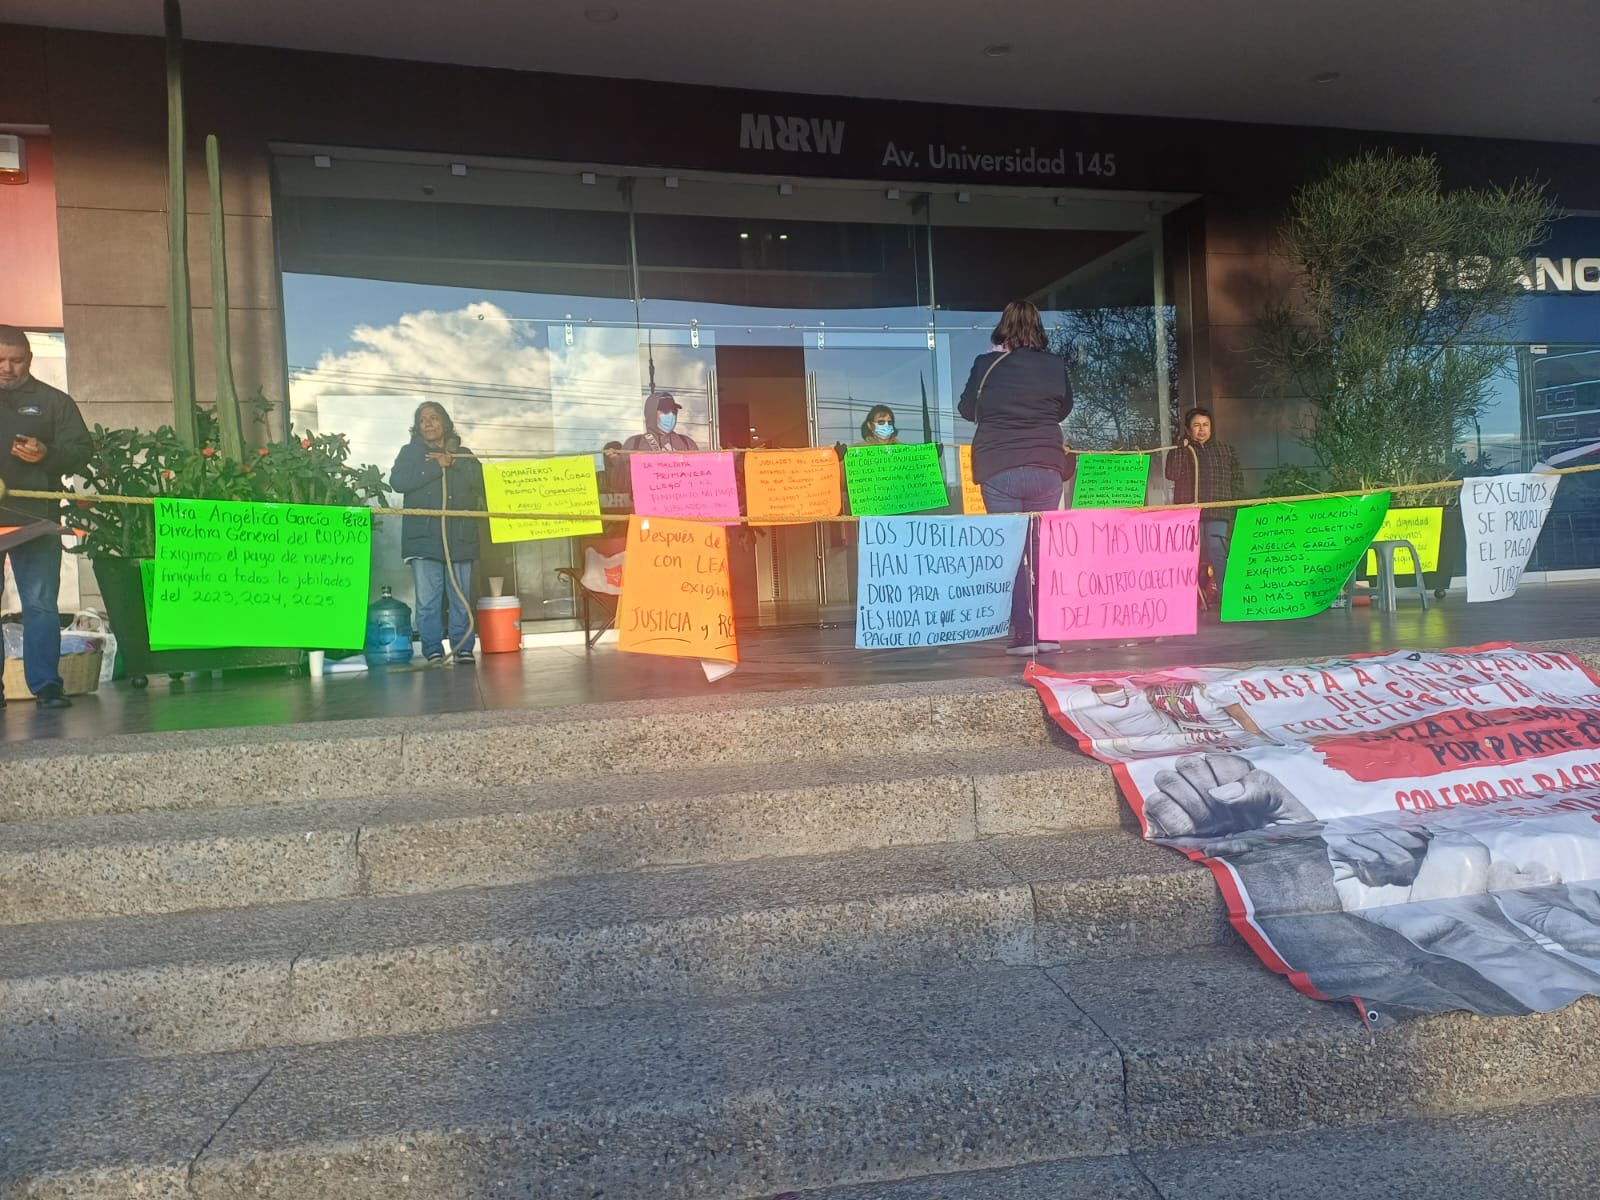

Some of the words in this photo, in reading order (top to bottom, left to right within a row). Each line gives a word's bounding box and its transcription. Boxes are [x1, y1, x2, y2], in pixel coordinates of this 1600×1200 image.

[882, 141, 919, 169] Av.
[928, 144, 1065, 175] Universidad
[1075, 152, 1117, 177] 145
[1473, 481, 1547, 505] EXIGIMOS
[160, 502, 196, 520] Mtra
[1255, 517, 1268, 526] NO
[159, 522, 221, 540] Directora
[226, 528, 280, 543] General
[287, 530, 308, 546] del
[1305, 522, 1363, 534] COLECTIVO
[1478, 511, 1497, 535] SE
[640, 529, 695, 548] Después
[705, 532, 721, 549] de
[865, 521, 897, 545] LOS
[904, 521, 1005, 548] JUBILADOS
[1049, 520, 1078, 557] NO
[1091, 521, 1129, 555] MAS
[160, 549, 222, 568] Exigimos
[227, 547, 239, 561] el
[243, 551, 276, 568] pago
[281, 550, 297, 564] de
[303, 552, 354, 566] nuestro
[1480, 541, 1497, 562] EL
[1504, 538, 1531, 559] PAGO
[654, 555, 682, 569] con
[870, 551, 907, 578] HAN
[914, 554, 1003, 579] TRABAJADO
[1246, 564, 1296, 578] EXIGIMOS
[1303, 564, 1332, 576] PAGO
[235, 570, 270, 585] todos
[298, 572, 352, 589] jubilados
[1050, 569, 1069, 596] AL
[1259, 579, 1316, 589] JUBILADOS
[160, 589, 181, 602] del
[868, 583, 902, 605] DURO
[909, 585, 940, 604] PARA
[948, 580, 1011, 600] CONTRIBUIR
[1243, 596, 1258, 604] NO
[887, 609, 920, 628] HORA
[925, 611, 938, 626] DE
[940, 609, 956, 628] QUE
[960, 609, 972, 623] SE
[976, 605, 995, 619] LES
[1062, 605, 1091, 631] DEL
[1100, 598, 1168, 629] TRABAJO
[1246, 602, 1306, 616] EXIGIMOS
[629, 607, 692, 632] JUSTICIA
[701, 625, 709, 640] y
[862, 631, 905, 647] PAGUE
[909, 631, 921, 646] LO
[1351, 666, 1377, 687] A
[1323, 690, 1385, 712] DEL
[1427, 739, 1490, 766] POR
[1487, 729, 1582, 760] PARTE
